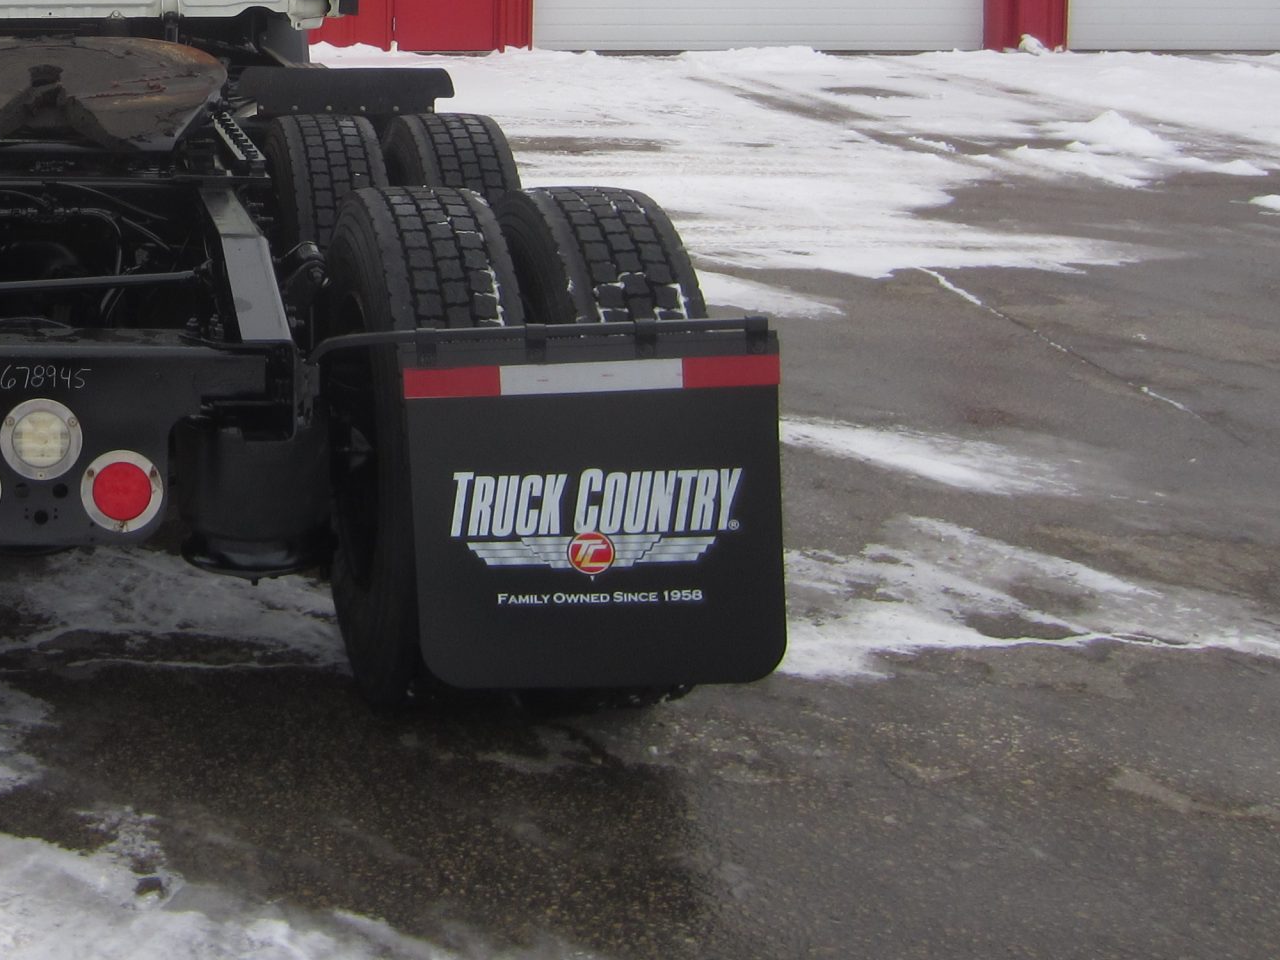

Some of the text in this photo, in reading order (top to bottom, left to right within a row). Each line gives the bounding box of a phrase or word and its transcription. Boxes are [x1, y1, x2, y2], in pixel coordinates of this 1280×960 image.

[0, 365, 91, 389] 678945
[450, 468, 743, 537] TRUCK COUNTRY
[497, 589, 703, 604] FAMILY OWNED SINCE 1958
